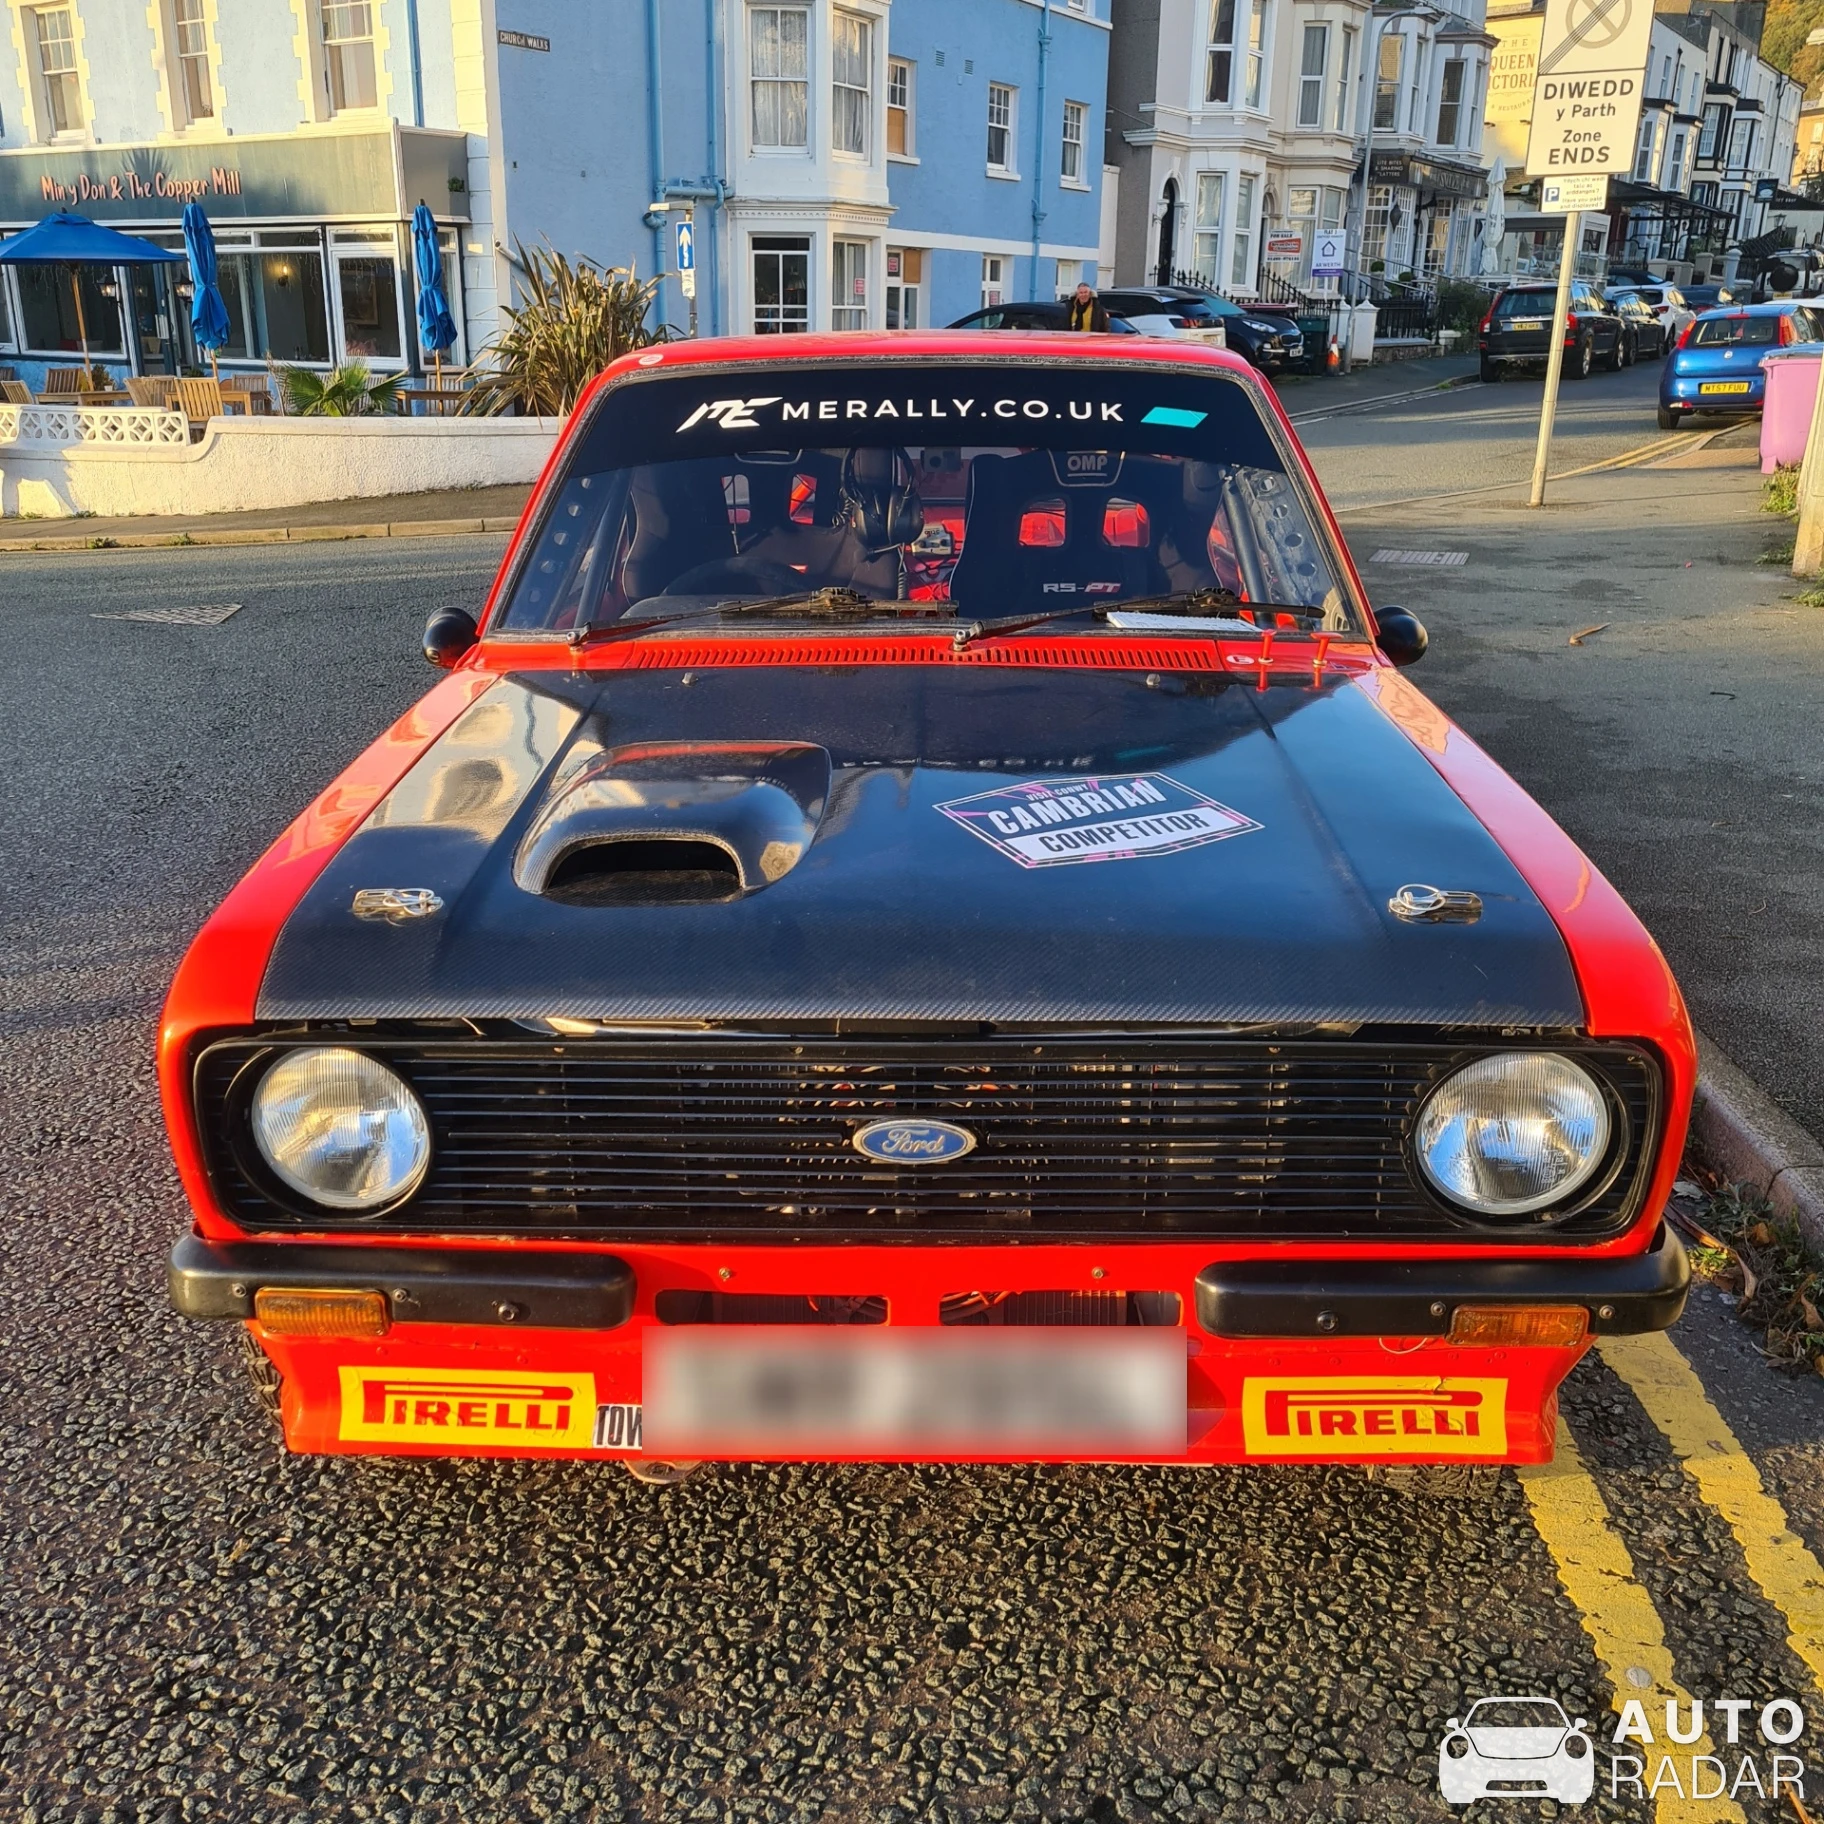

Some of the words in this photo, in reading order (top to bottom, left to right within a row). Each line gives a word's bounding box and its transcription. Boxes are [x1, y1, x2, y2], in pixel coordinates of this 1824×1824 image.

[500, 32, 525, 46] CHURCH
[526, 36, 548, 50] WALKS
[1502, 39, 1528, 47] THE
[1490, 54, 1535, 72] QUEEN
[1487, 73, 1537, 89] ICTORI
[1544, 79, 1633, 100] DIWEDD
[1498, 97, 1533, 111] RESTAURA
[1556, 108, 1565, 121] y
[1572, 103, 1616, 118] Parth
[1562, 130, 1601, 143] Zone
[1549, 146, 1610, 165] ENDS
[40, 176, 66, 201] Min
[67, 184, 78, 205] y
[79, 174, 106, 200] Don
[110, 176, 124, 200] &
[125, 171, 152, 199] The
[155, 171, 209, 203] Copper
[212, 167, 241, 195] Mill
[783, 399, 1124, 422] MERALLY.CO.UK
[1068, 456, 1107, 471] OMP
[1026, 790, 1053, 801] VISIT
[1054, 783, 1088, 795] CONWY
[988, 780, 1166, 834] CAMBRIAN
[1039, 813, 1210, 852] COMPETITOR
[882, 1129, 946, 1154] Ford
[362, 1380, 574, 1430] PIRELLI
[1265, 1390, 1483, 1436] PIRELLI
[596, 1405, 642, 1447] TOW
